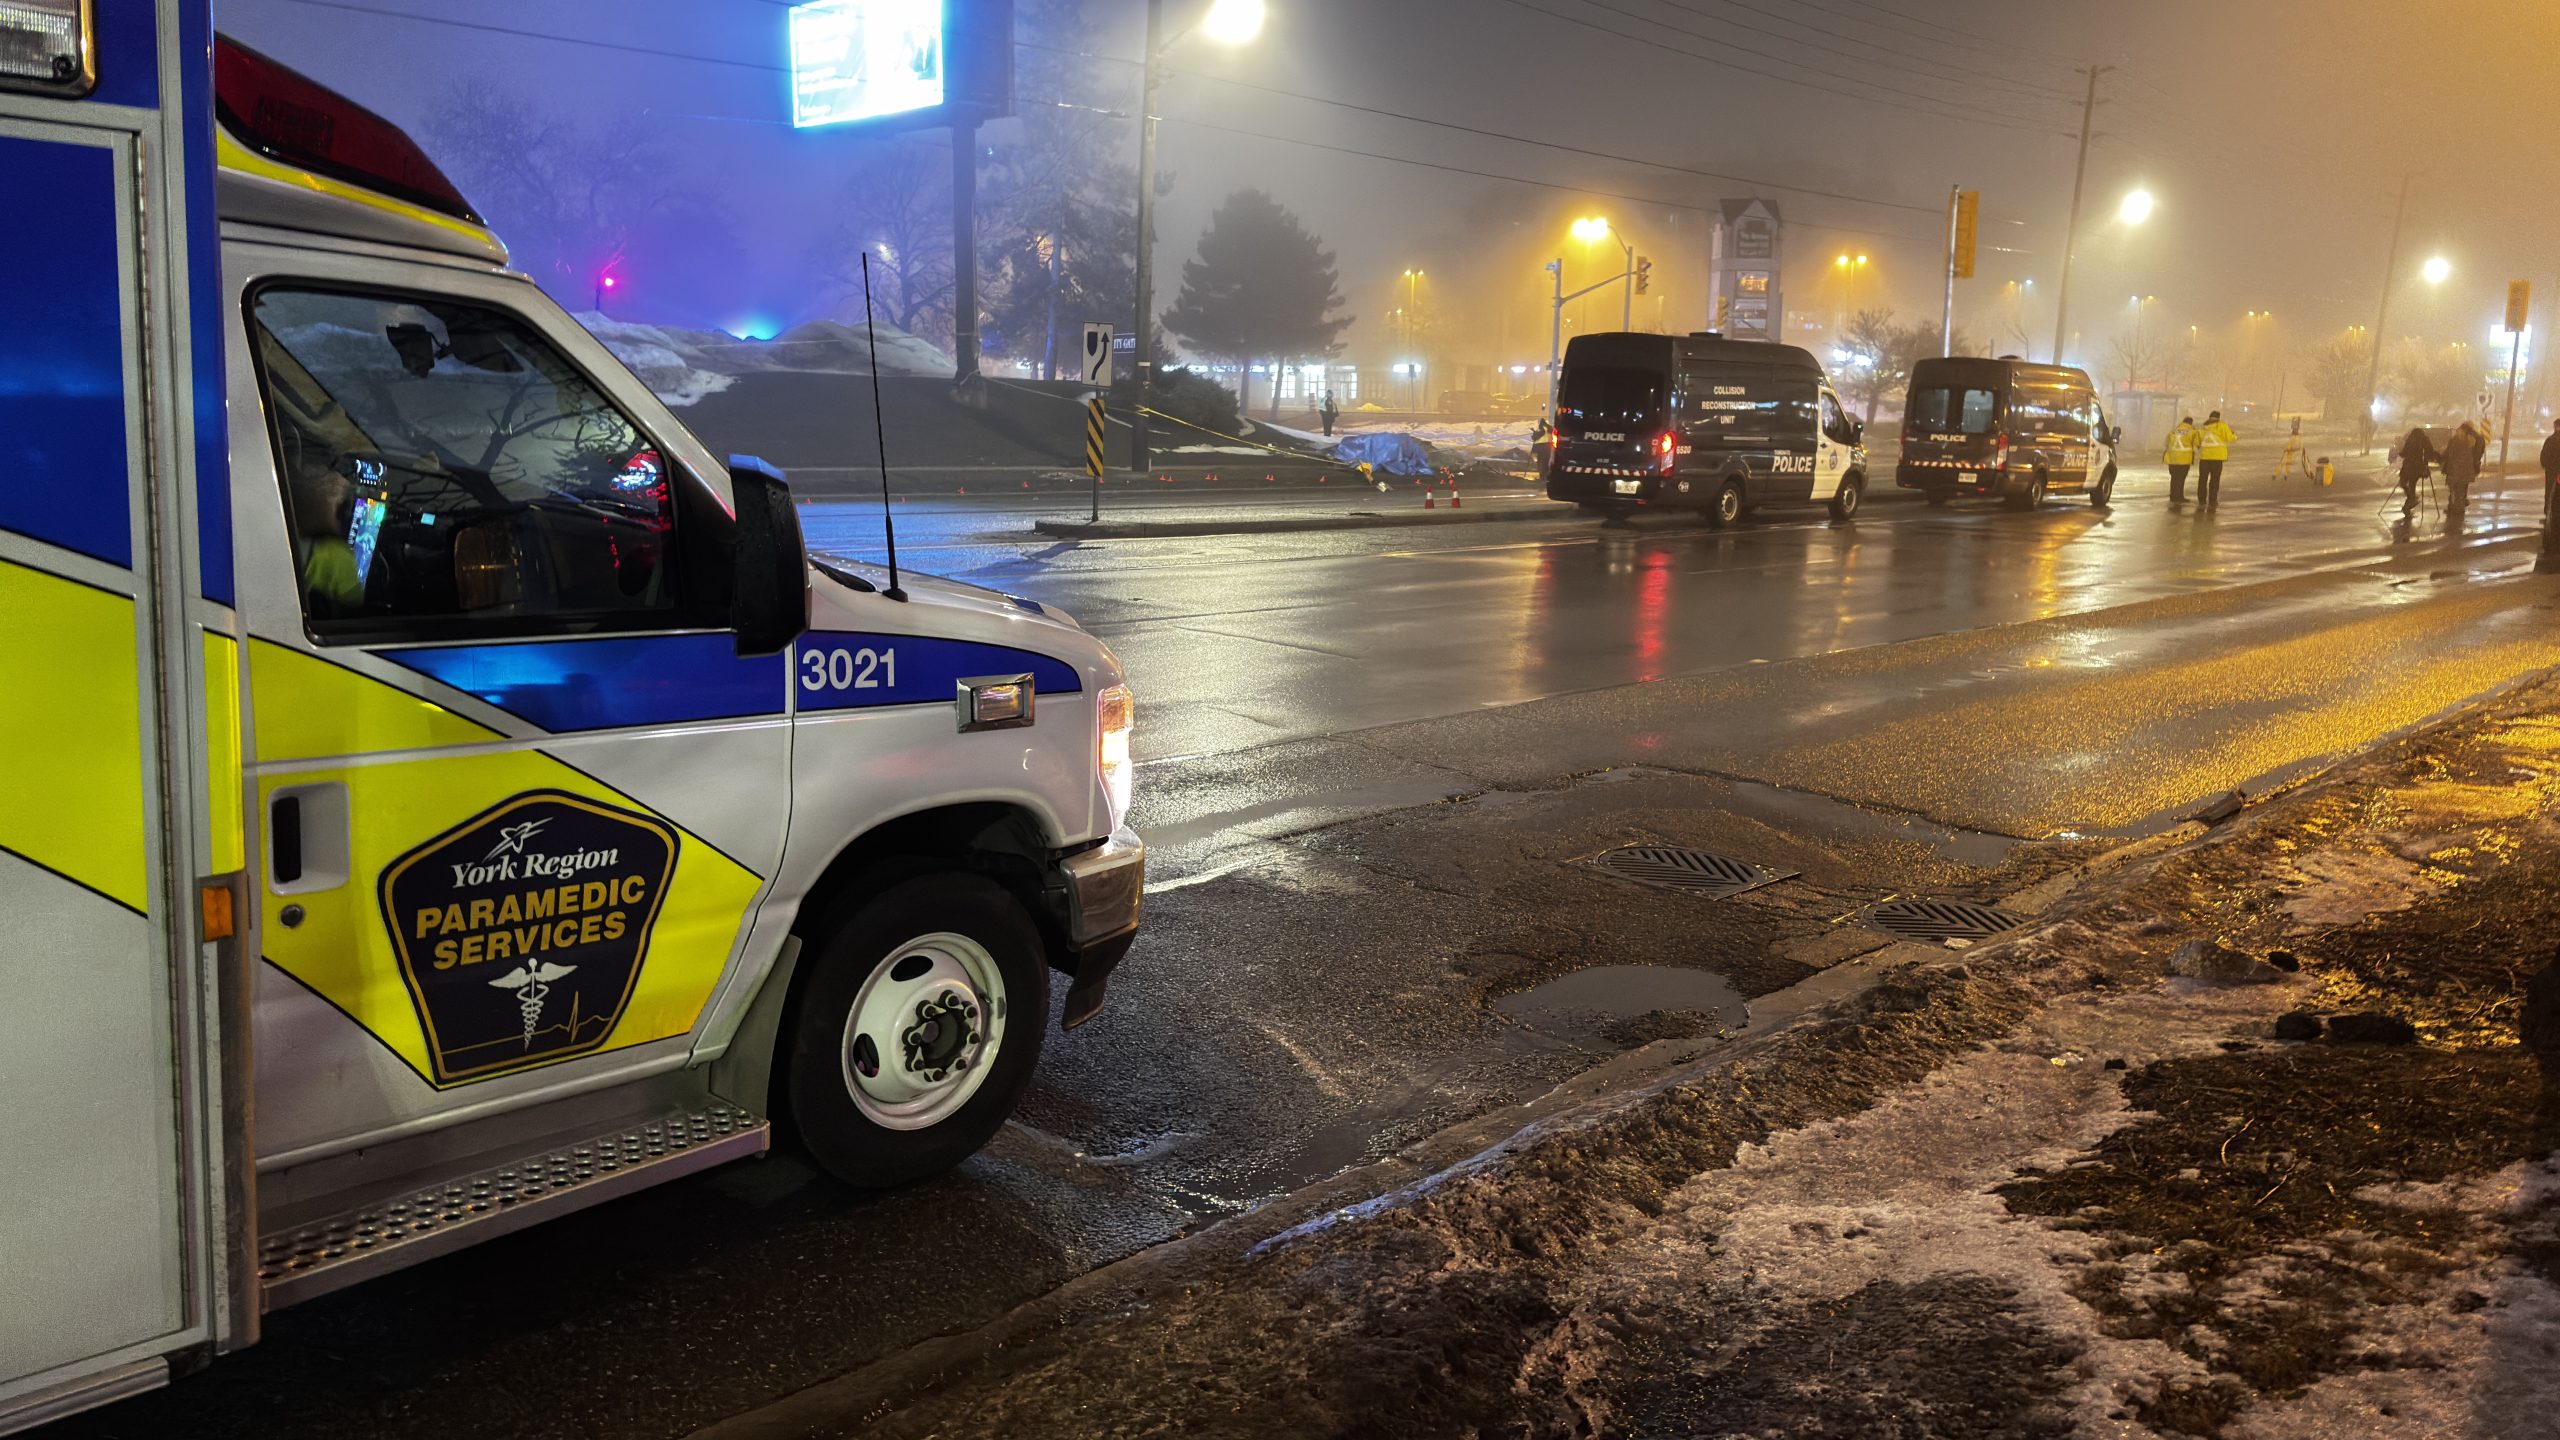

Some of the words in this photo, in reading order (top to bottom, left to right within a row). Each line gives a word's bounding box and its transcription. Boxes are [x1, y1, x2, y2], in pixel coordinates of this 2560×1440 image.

[1713, 386, 1745, 395] COLLISION
[1701, 401, 1756, 410] RECONSTRUCTION
[1720, 415, 1735, 424] UNIT
[1584, 431, 1625, 441] POLICE
[1929, 433, 1967, 442] POLICE
[1771, 455, 1812, 472] POLICE
[801, 648, 896, 691] 3021
[451, 854, 518, 888] York
[521, 847, 620, 880] Region
[416, 875, 646, 939] PARAMEDIC
[433, 911, 627, 971] SERVICES
